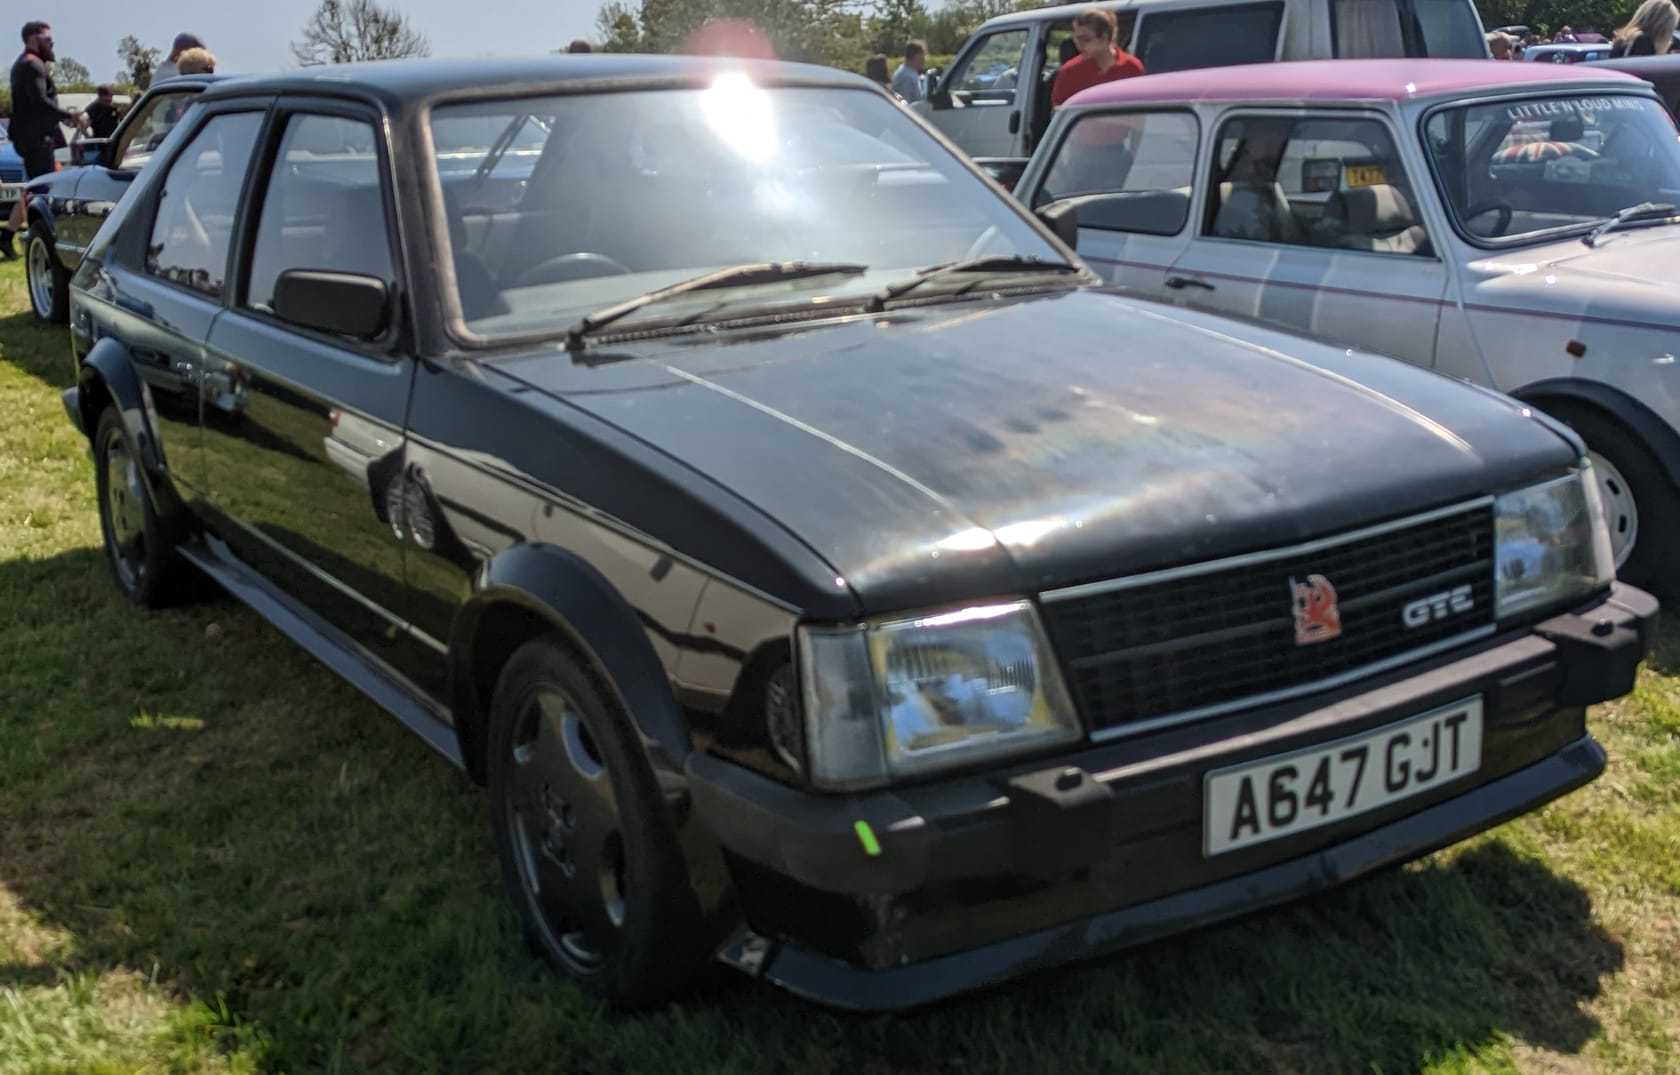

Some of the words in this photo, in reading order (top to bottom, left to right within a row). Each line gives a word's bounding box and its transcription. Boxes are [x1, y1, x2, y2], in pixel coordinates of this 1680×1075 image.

[1403, 585, 1473, 627] GTE
[1229, 745, 1369, 840] A647
[1385, 711, 1467, 794] GJT
